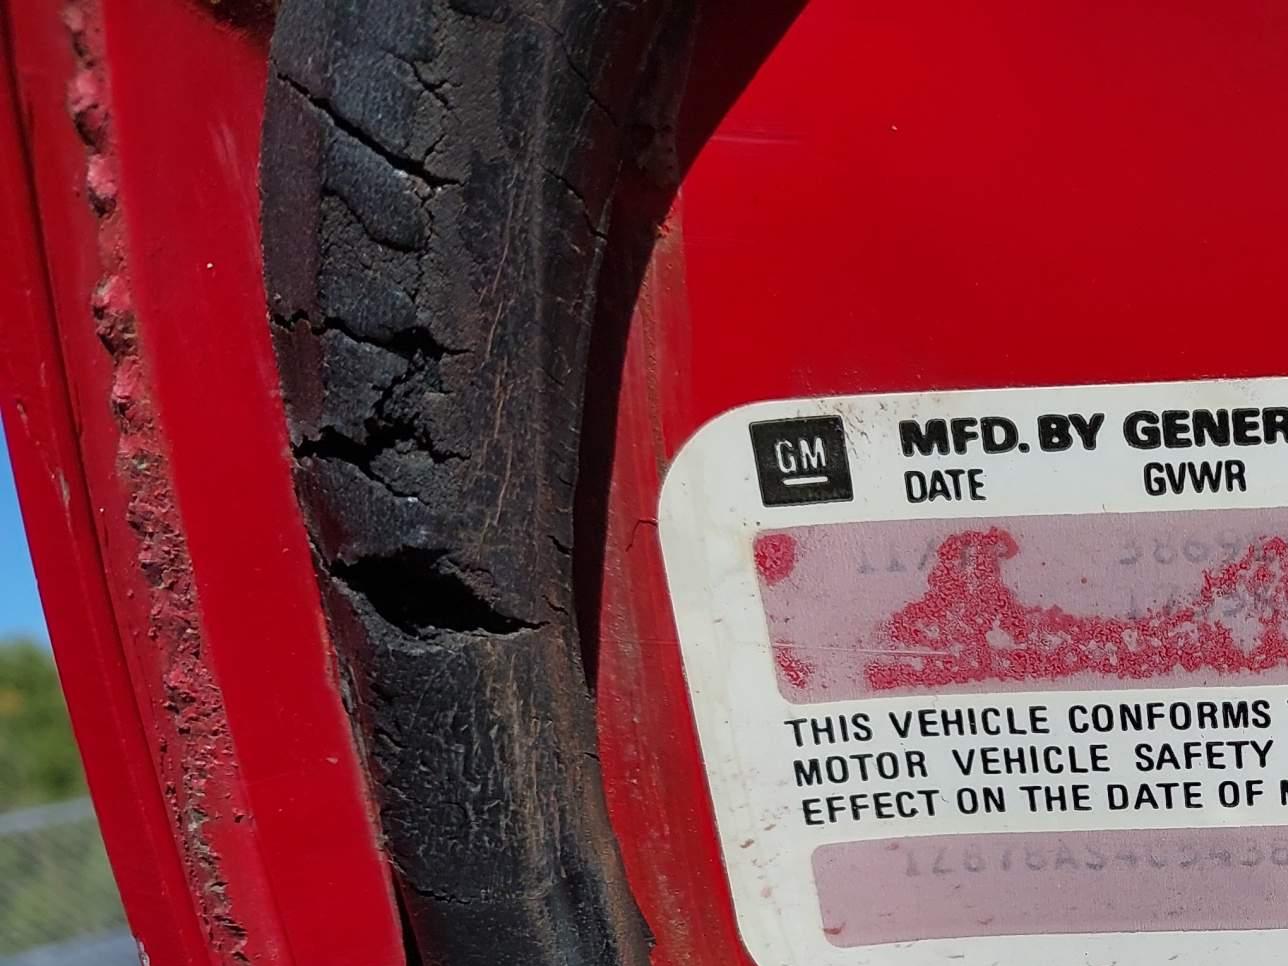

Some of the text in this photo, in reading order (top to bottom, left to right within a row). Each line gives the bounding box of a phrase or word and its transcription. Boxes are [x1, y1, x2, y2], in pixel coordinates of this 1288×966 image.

[774, 435, 828, 475] GM
[900, 417, 1031, 457] MFD.
[1038, 414, 1105, 452] BY
[904, 468, 987, 503] DATE
[1144, 460, 1247, 497] GVWR
[784, 712, 874, 748] THIS
[888, 705, 1050, 739] VEHICLE
[1067, 699, 1273, 734] CONFORMS
[793, 751, 928, 788] MOTOR
[951, 743, 1112, 778] VEHICLE
[1135, 739, 1274, 773] SAFETY
[802, 789, 940, 827] EFFECT
[958, 785, 1006, 816] ON
[1020, 783, 1092, 814] THE
[1107, 781, 1203, 812] DATE
[1219, 778, 1264, 809] OF
